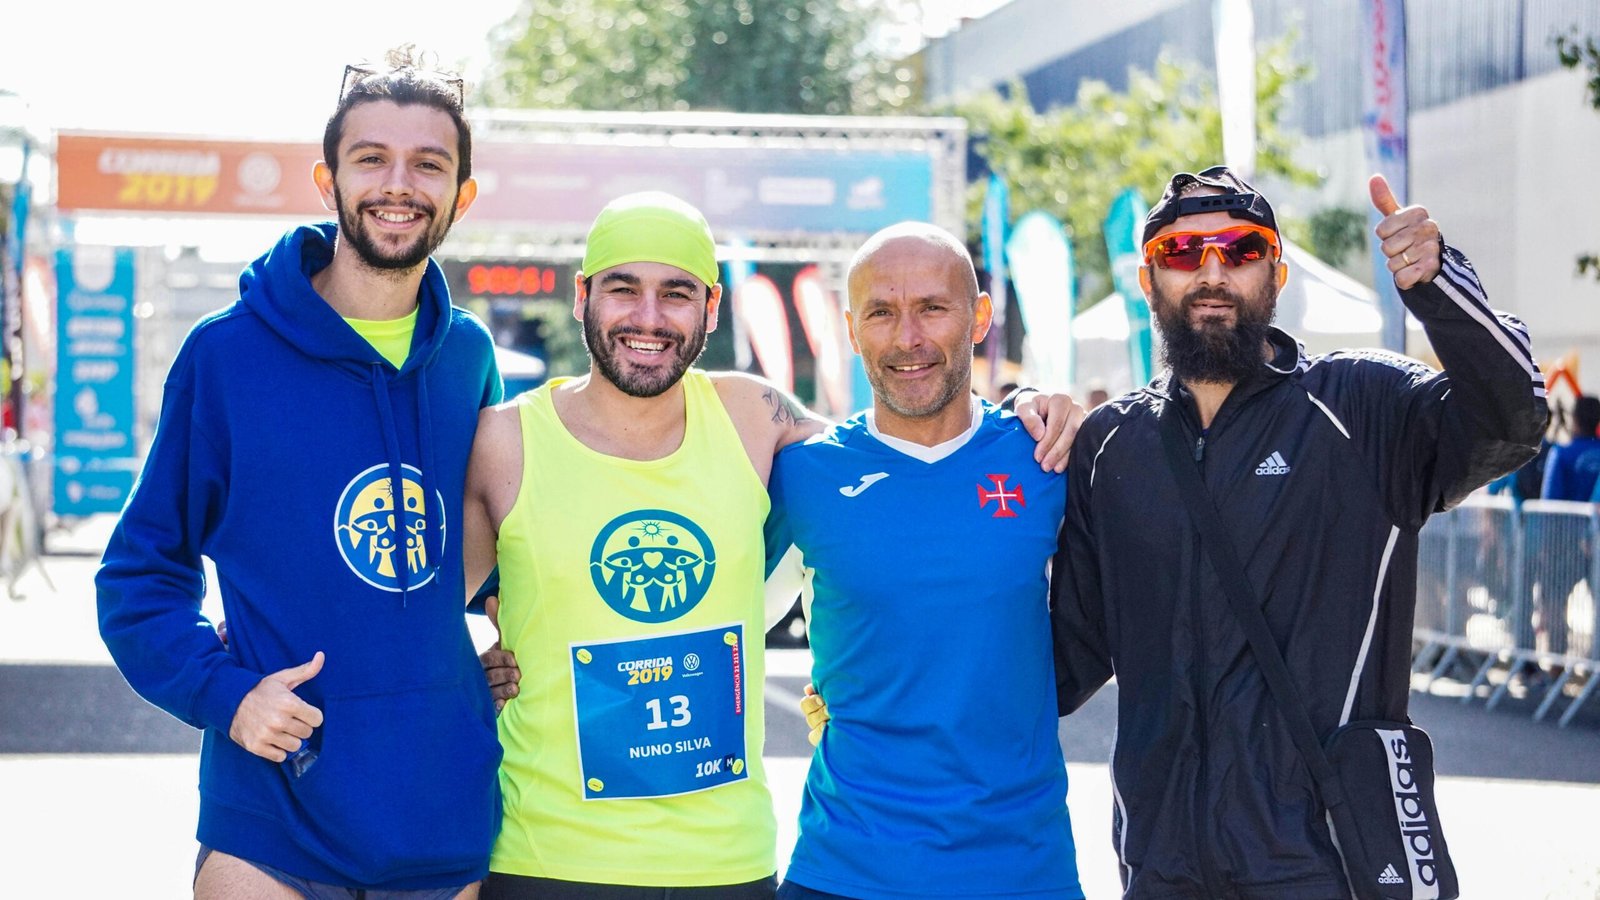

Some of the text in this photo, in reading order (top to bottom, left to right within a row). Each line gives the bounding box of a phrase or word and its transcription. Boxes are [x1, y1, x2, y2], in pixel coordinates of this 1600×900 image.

[118, 173, 219, 206] 2019
[1255, 466, 1291, 475] adidas
[617, 656, 673, 672] CORRIDA
[627, 665, 673, 686] 2019
[645, 694, 692, 731] 13
[629, 736, 711, 759] NUNO SILVA
[695, 758, 722, 778] 10K
[1390, 738, 1437, 887] adidas
[1378, 876, 1404, 884] adidas
